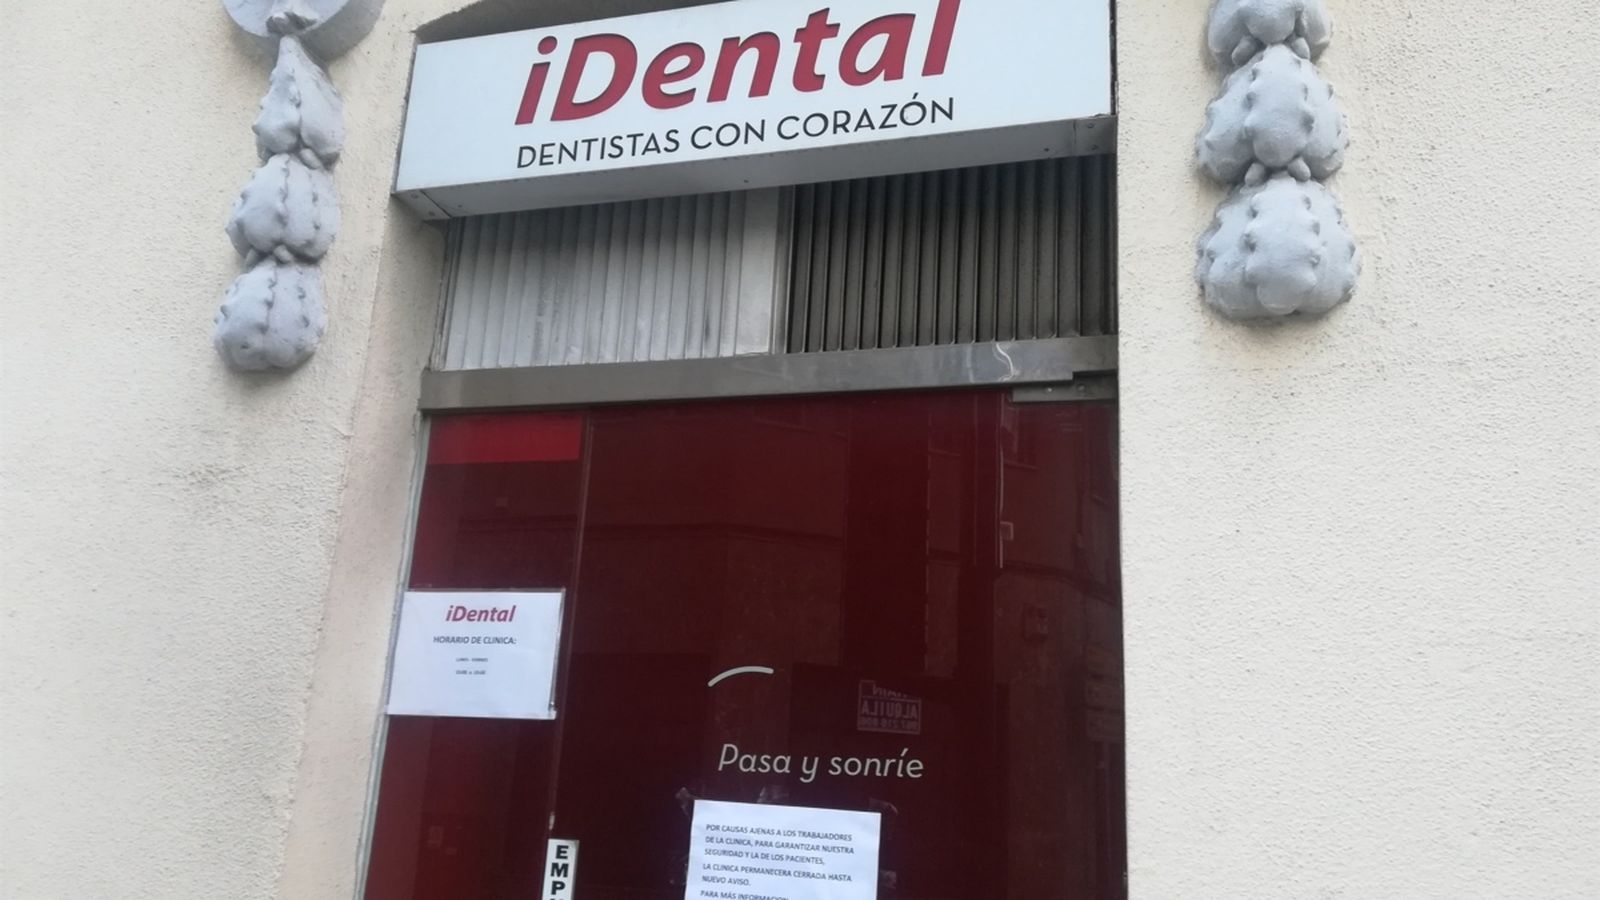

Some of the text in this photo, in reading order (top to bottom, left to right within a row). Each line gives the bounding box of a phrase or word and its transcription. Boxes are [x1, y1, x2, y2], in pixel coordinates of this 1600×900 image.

[514, 0, 961, 126] iDental
[516, 92, 955, 169] DENTISTAS CON CORAZÓN
[445, 604, 517, 622] iDental
[433, 636, 517, 645] HORARIO DE CLINICA:
[718, 743, 924, 783] Pasa y sonríe
[706, 824, 853, 842] POR CAUSAS AJENAS A LOS TRABAJADORES
[704, 848, 744, 858] SEGURIDAD
[751, 852, 760, 860] LA
[761, 853, 770, 861] DE
[716, 837, 725, 845] LA
[755, 840, 774, 848] PARA
[775, 841, 821, 851] GARANTIZAR
[822, 845, 855, 855] NUESTRA
[550, 844, 569, 900] EMP
[702, 875, 727, 884] NUEVO
[713, 864, 740, 872] CLINICA
[741, 866, 792, 877] PERMANECERA
[793, 870, 827, 880] CERRADA
[828, 873, 853, 882] HASTA
[701, 890, 719, 898] PARA
